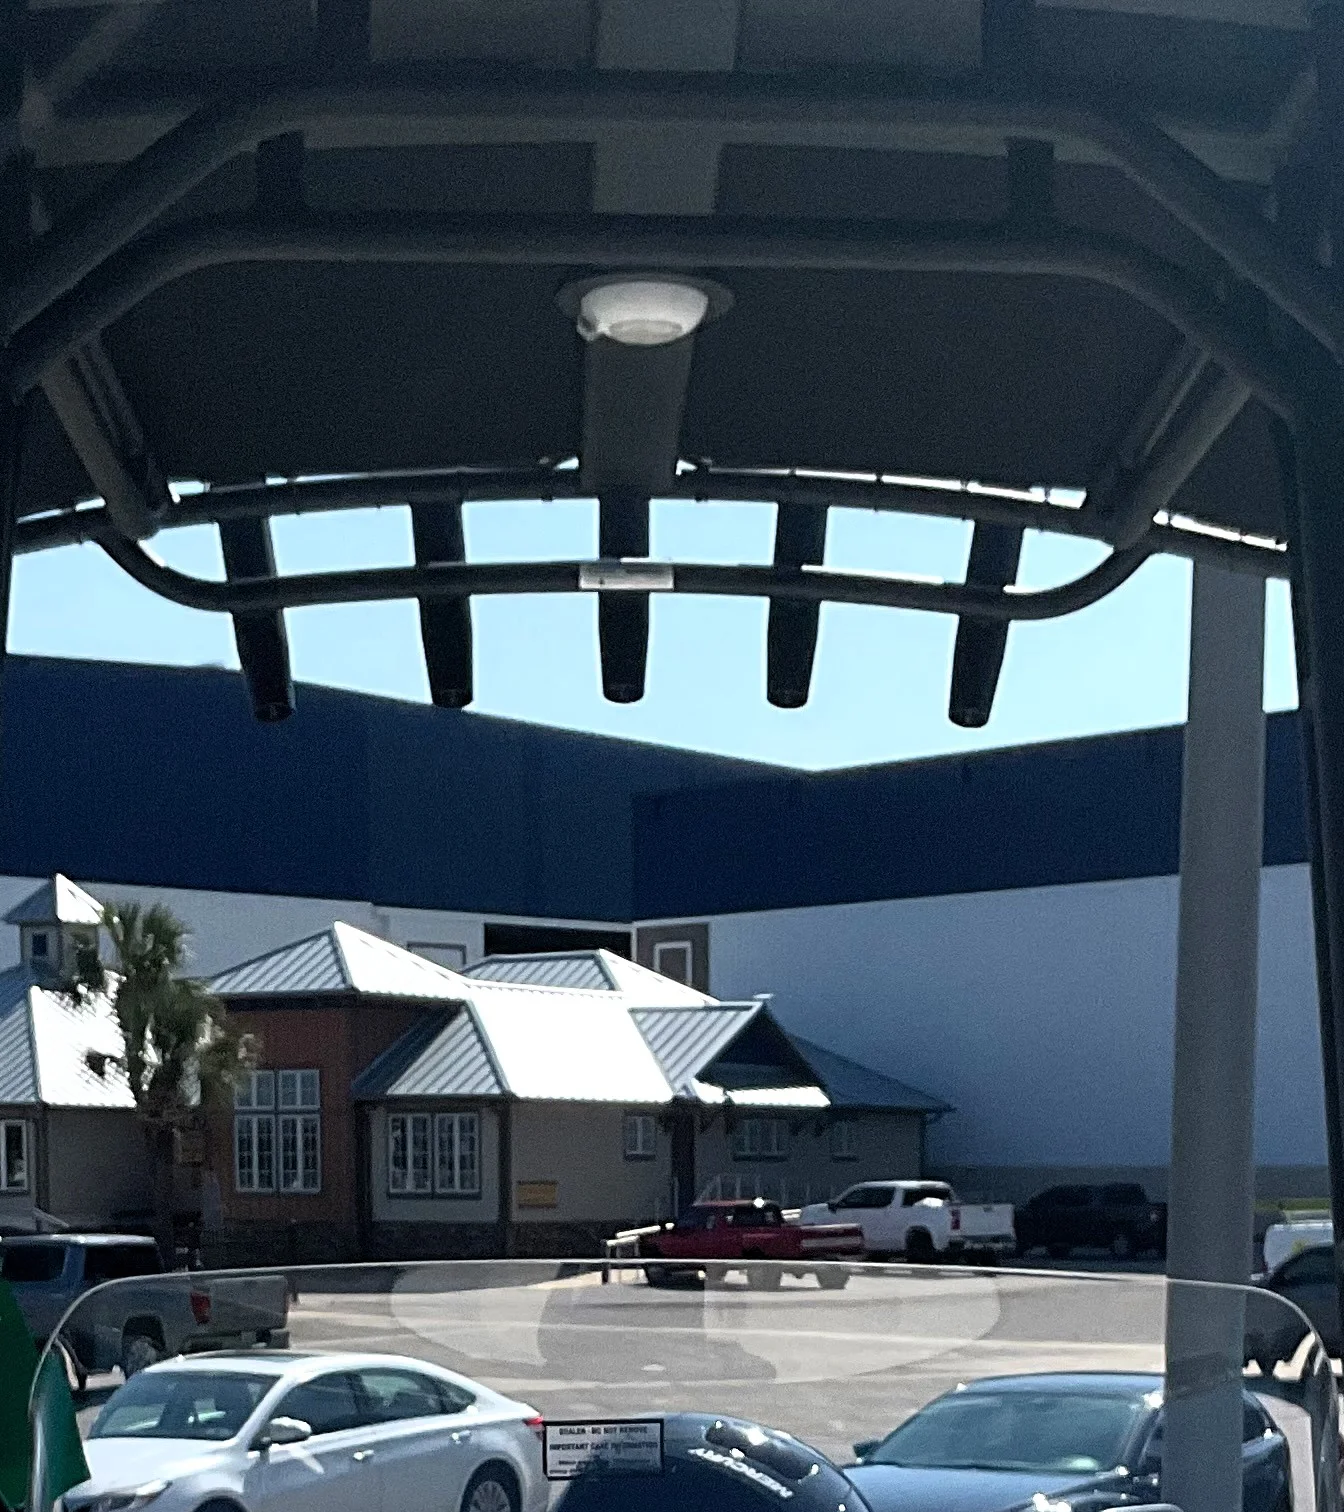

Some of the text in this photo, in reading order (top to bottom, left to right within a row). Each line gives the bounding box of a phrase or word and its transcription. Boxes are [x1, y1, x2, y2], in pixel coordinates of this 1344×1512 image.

[603, 1426, 617, 1434] NOT
[619, 1426, 647, 1434] REMOVE
[549, 1443, 589, 1451] IMPORTANT
[687, 1447, 794, 1498] MERCURY
